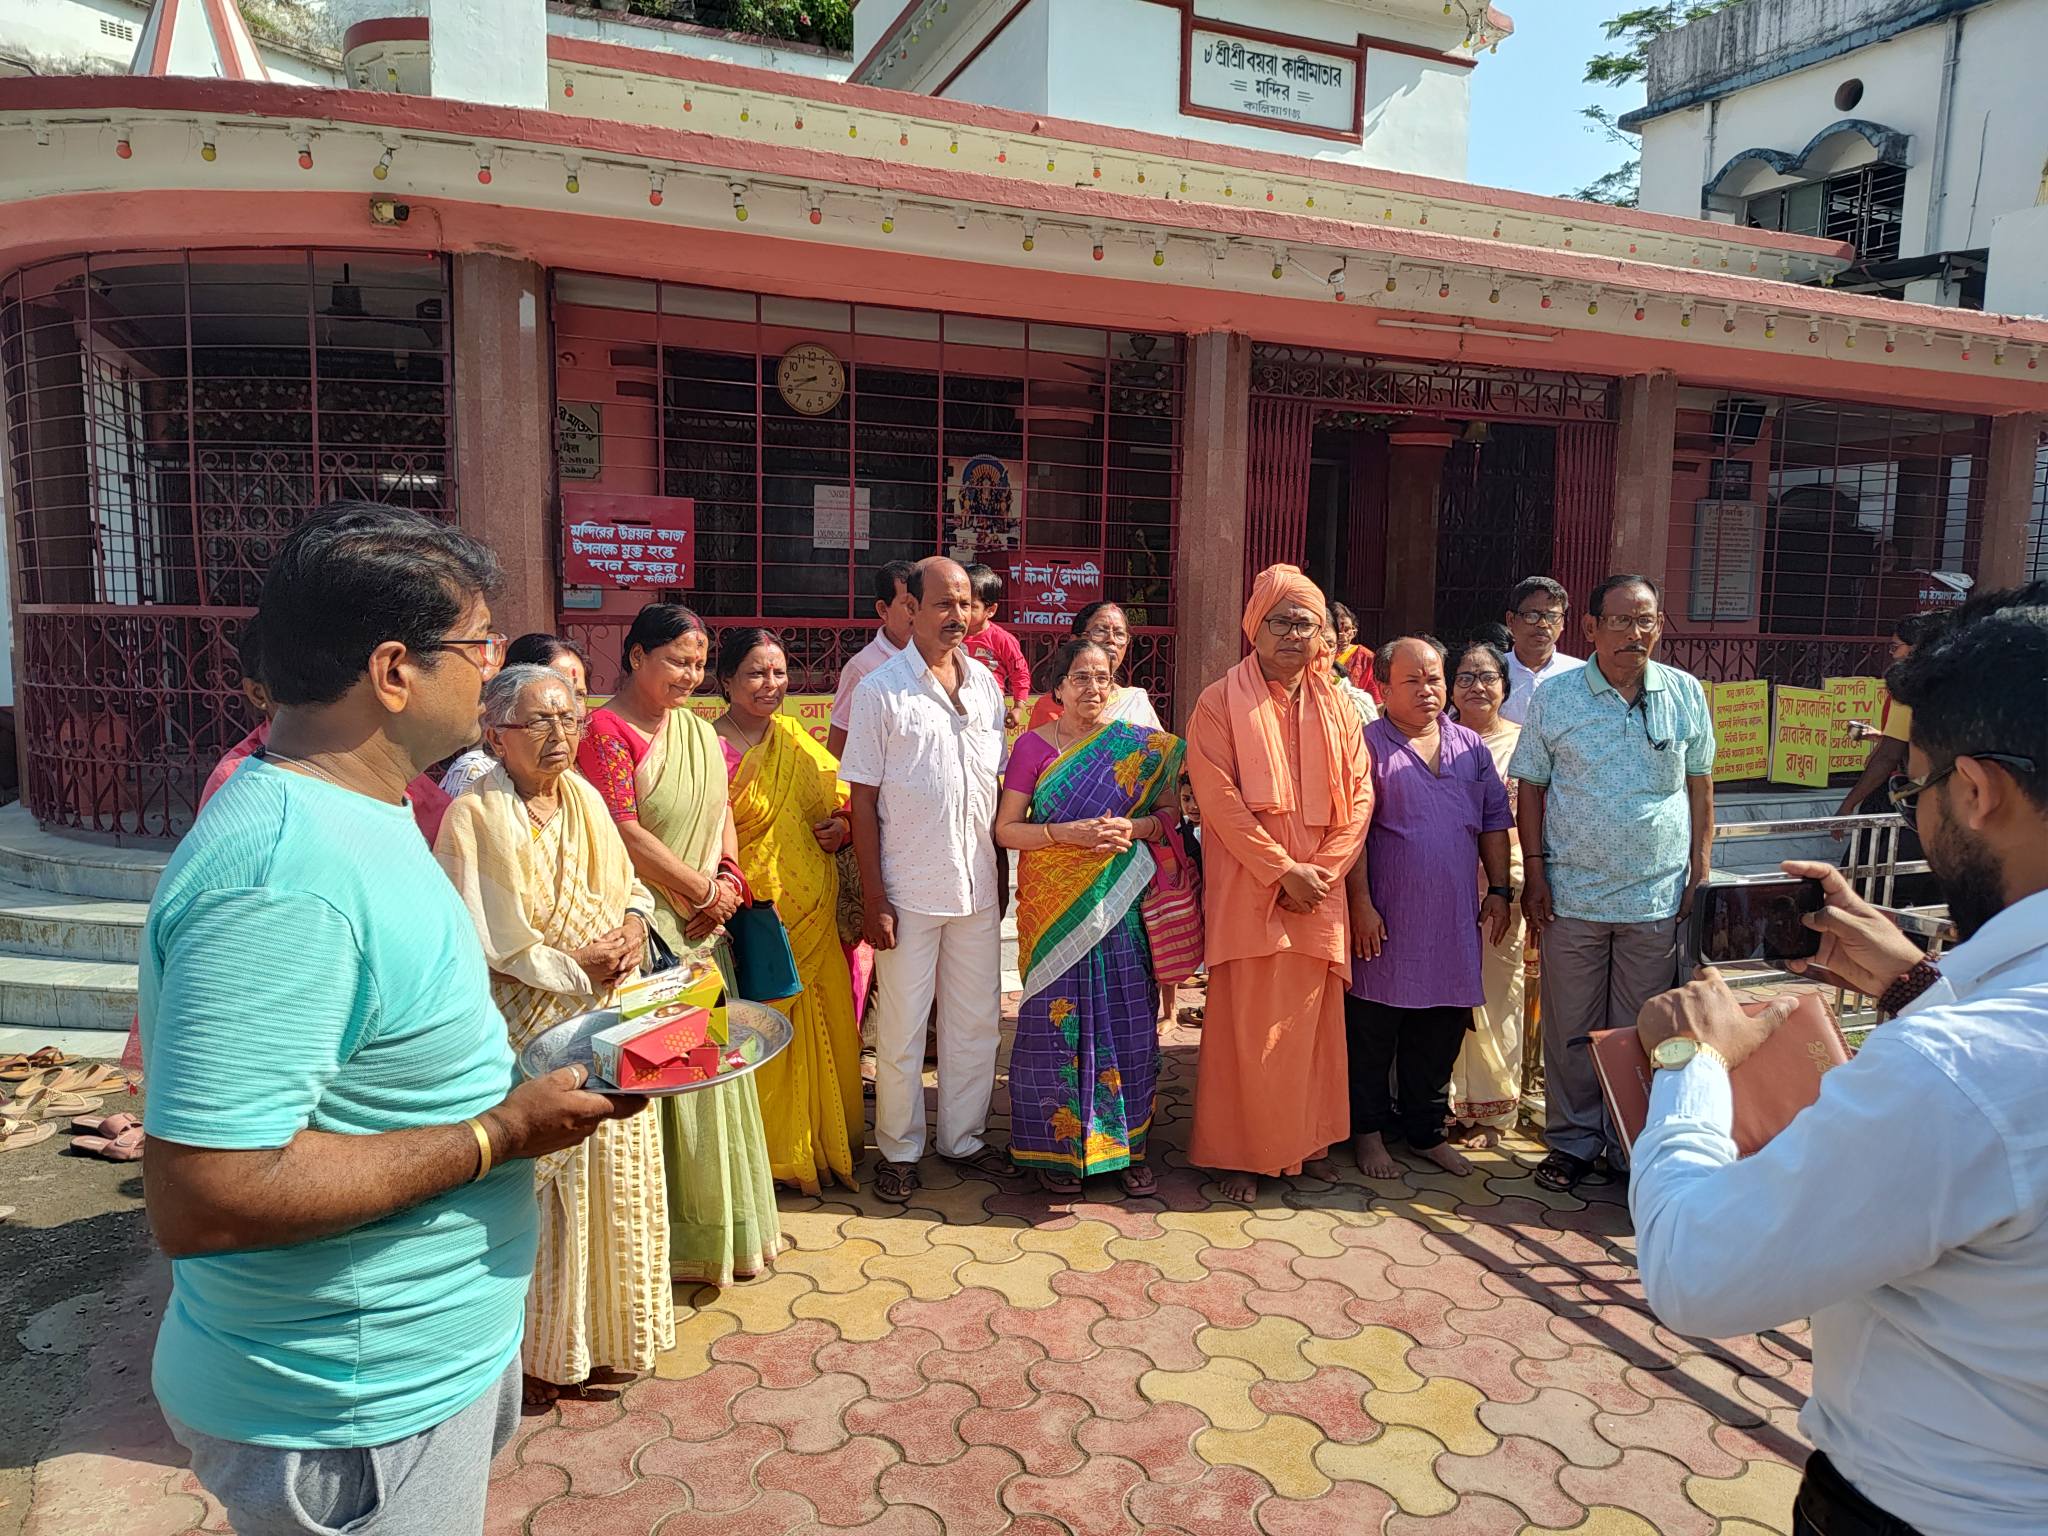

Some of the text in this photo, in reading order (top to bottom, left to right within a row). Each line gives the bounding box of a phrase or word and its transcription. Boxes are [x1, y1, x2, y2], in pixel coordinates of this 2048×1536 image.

[1281, 55, 1342, 88] কালীমাতার
[1255, 78, 1290, 101] মন্দির
[569, 521, 687, 543] মন্দিরের উন্নয়ন কাজ
[572, 539, 677, 559] উপলক্ষে মুক্ত হস্তে
[588, 559, 624, 572] দান
[1037, 588, 1068, 610] এই
[1834, 680, 1867, 696] আপনি
[1852, 701, 1873, 713] TV
[1779, 722, 1812, 744] মোবাইল
